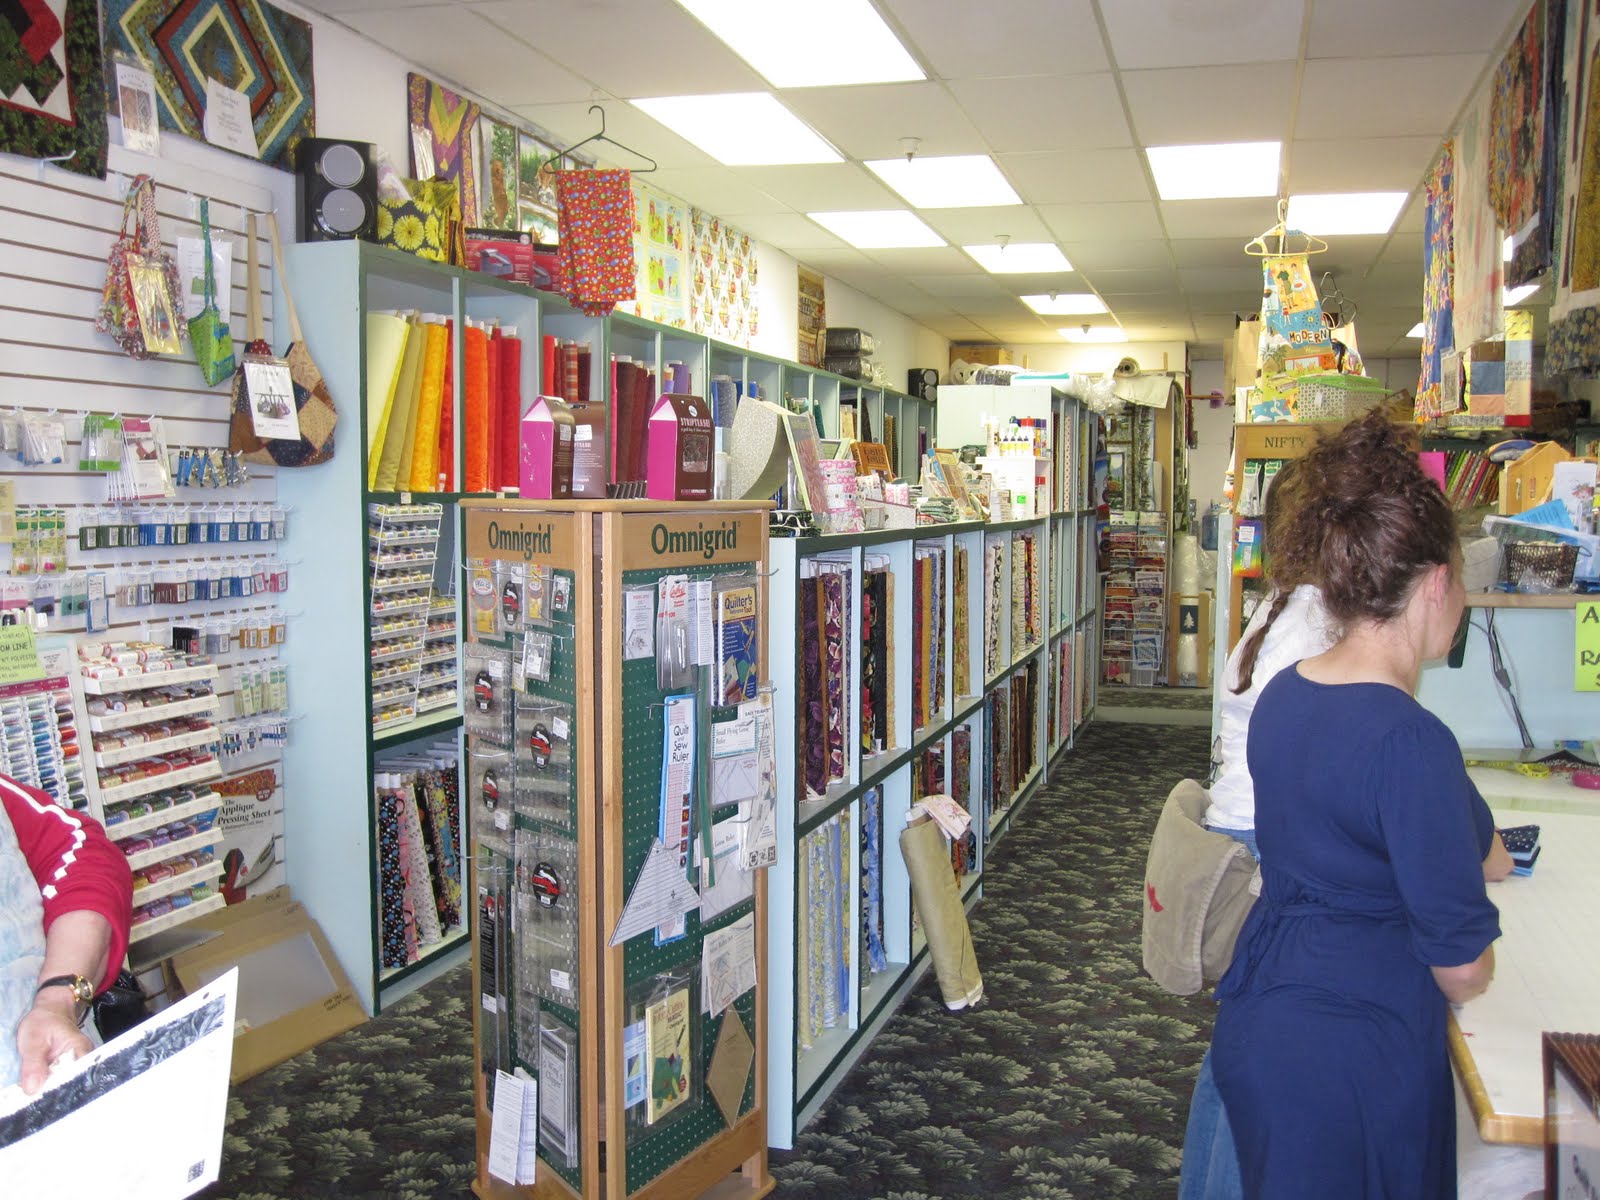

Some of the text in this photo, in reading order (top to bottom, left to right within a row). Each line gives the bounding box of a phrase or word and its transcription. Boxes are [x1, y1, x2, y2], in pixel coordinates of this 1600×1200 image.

[1289, 329, 1327, 343] MODERN
[488, 521, 552, 561] Omnigrid
[651, 521, 737, 559] Omnigrid
[725, 594, 753, 610] Quilter's
[12, 642, 28, 651] LINE
[673, 724, 689, 736] Quilt
[674, 741, 688, 751] Sew
[672, 751, 689, 762] Ruler
[221, 803, 255, 815] Applique
[217, 809, 271, 825] Pressing Sheet
